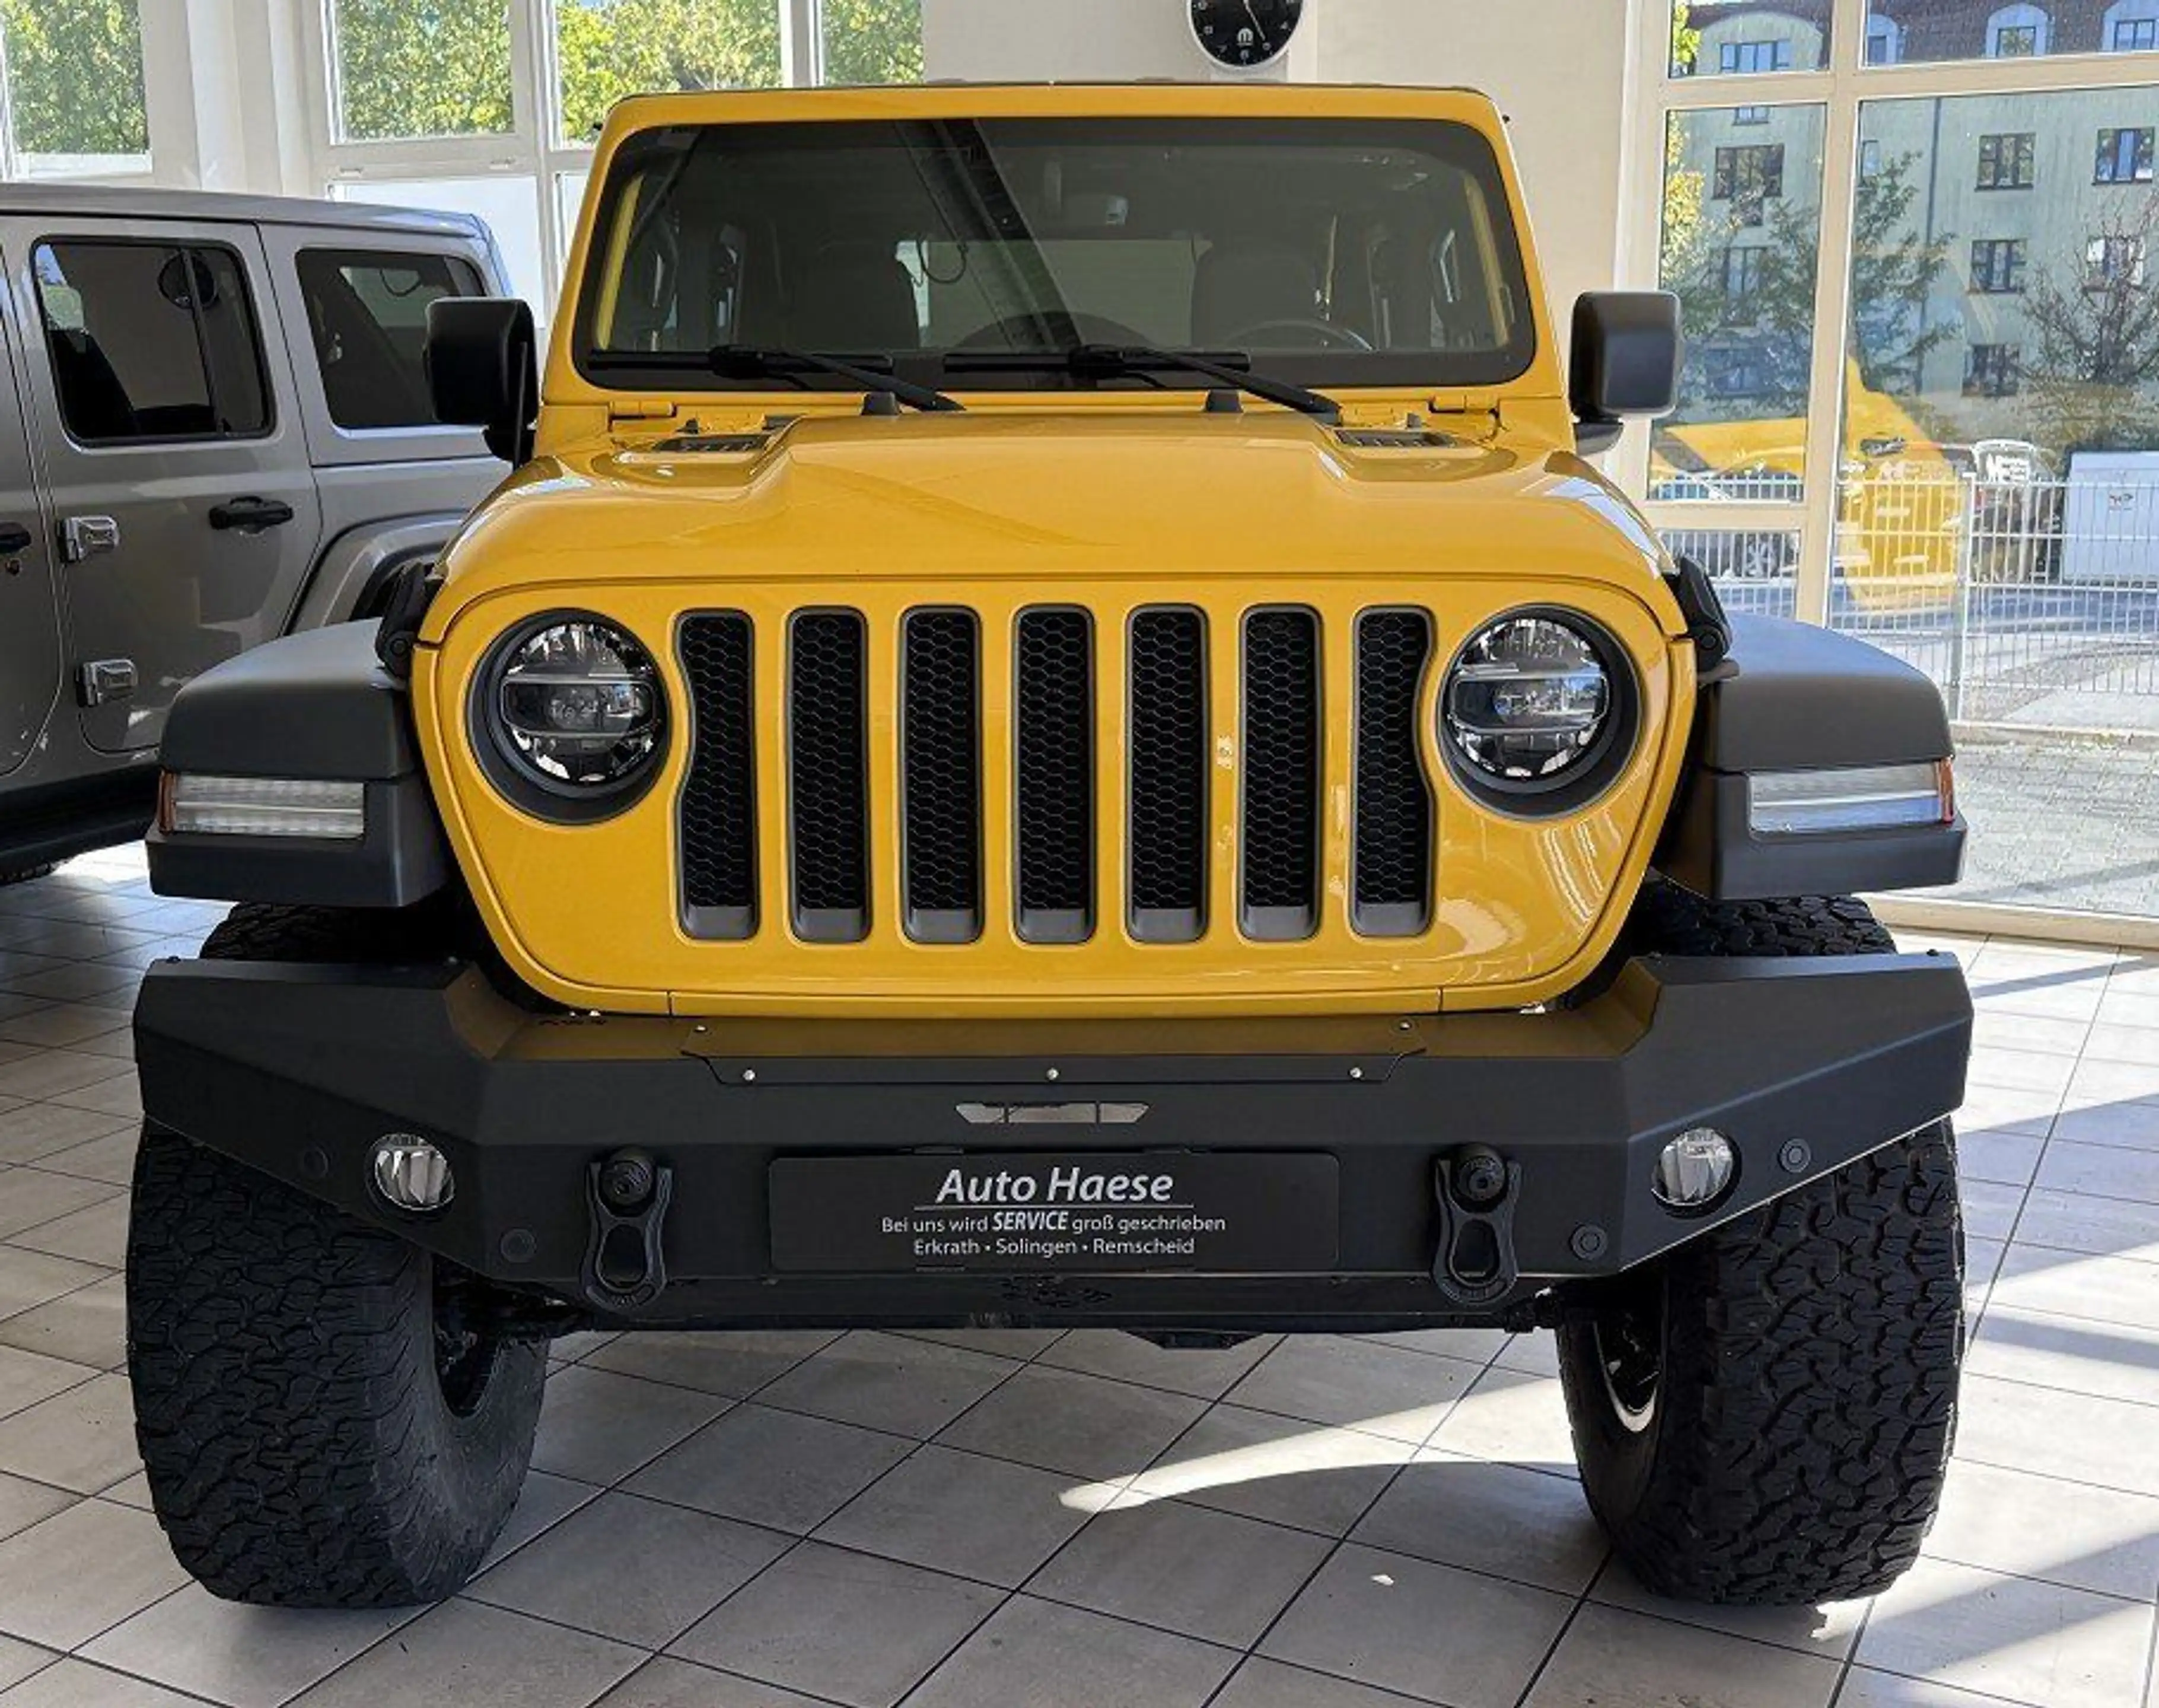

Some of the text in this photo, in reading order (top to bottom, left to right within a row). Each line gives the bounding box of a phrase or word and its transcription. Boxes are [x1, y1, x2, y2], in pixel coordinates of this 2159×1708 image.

[935, 1166, 1174, 1203] Auto Haese
[881, 1210, 1226, 1235] Bei uns wird SERVICE groß geschrieben
[913, 1237, 1195, 1259] Erkrath Solingen Remscheid
